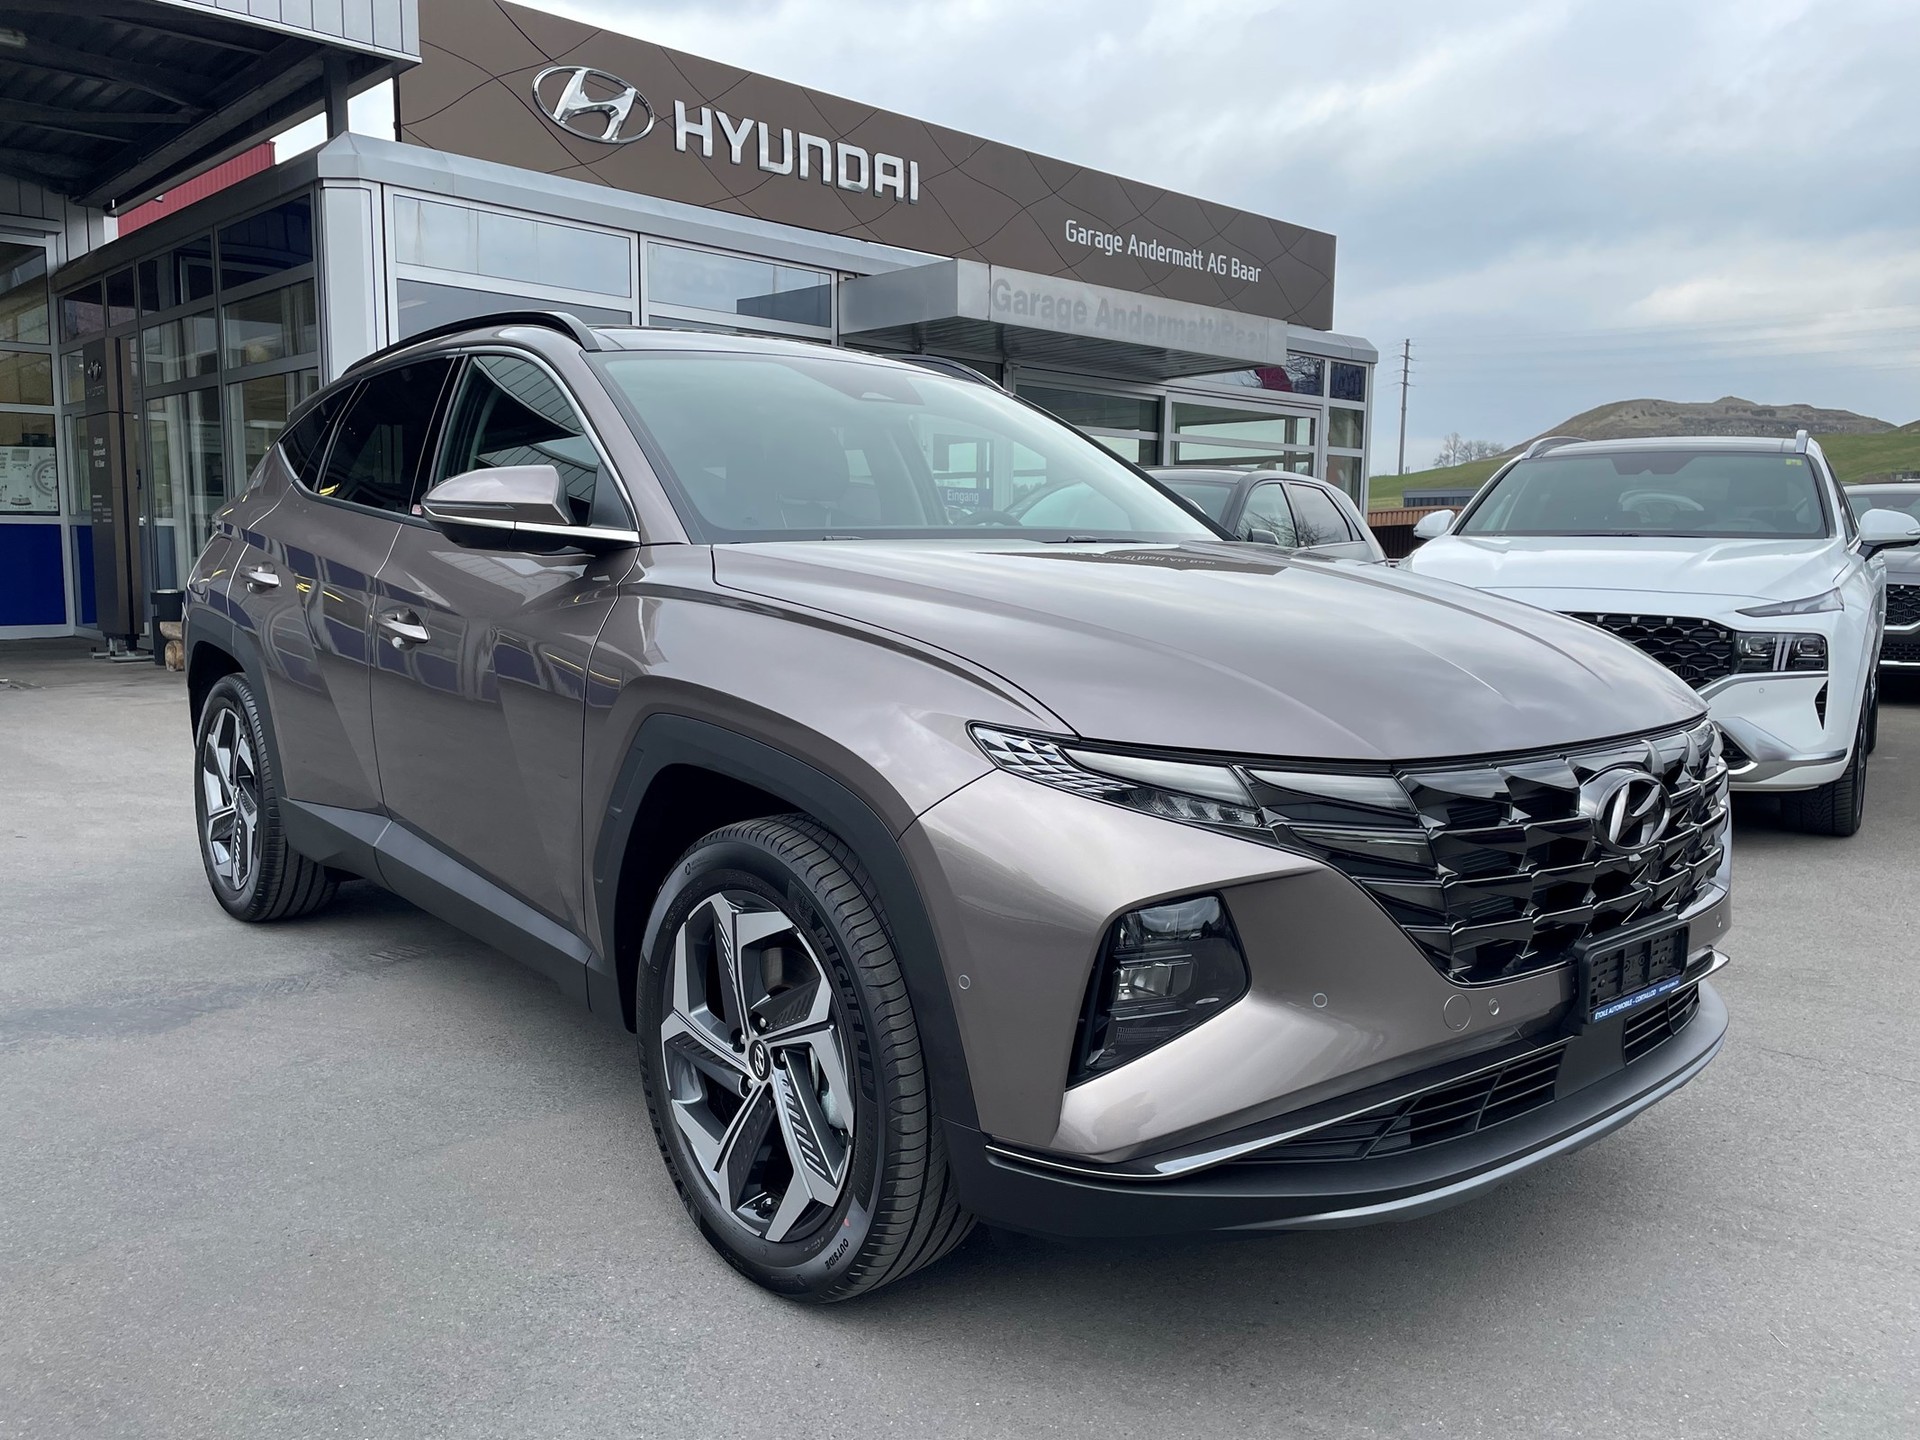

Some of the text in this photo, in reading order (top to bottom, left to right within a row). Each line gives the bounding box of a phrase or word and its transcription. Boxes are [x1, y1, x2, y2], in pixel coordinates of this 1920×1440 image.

[673, 99, 919, 204] HYUNDAI
[1065, 219, 1262, 283] Garage Andermatt AG Baar
[992, 278, 1087, 331] Garage
[1094, 297, 1213, 344] Andermatt
[947, 489, 979, 505] Eingang
[816, 926, 873, 1087] MICHELIN
[825, 1238, 849, 1271] OUTSIDE
